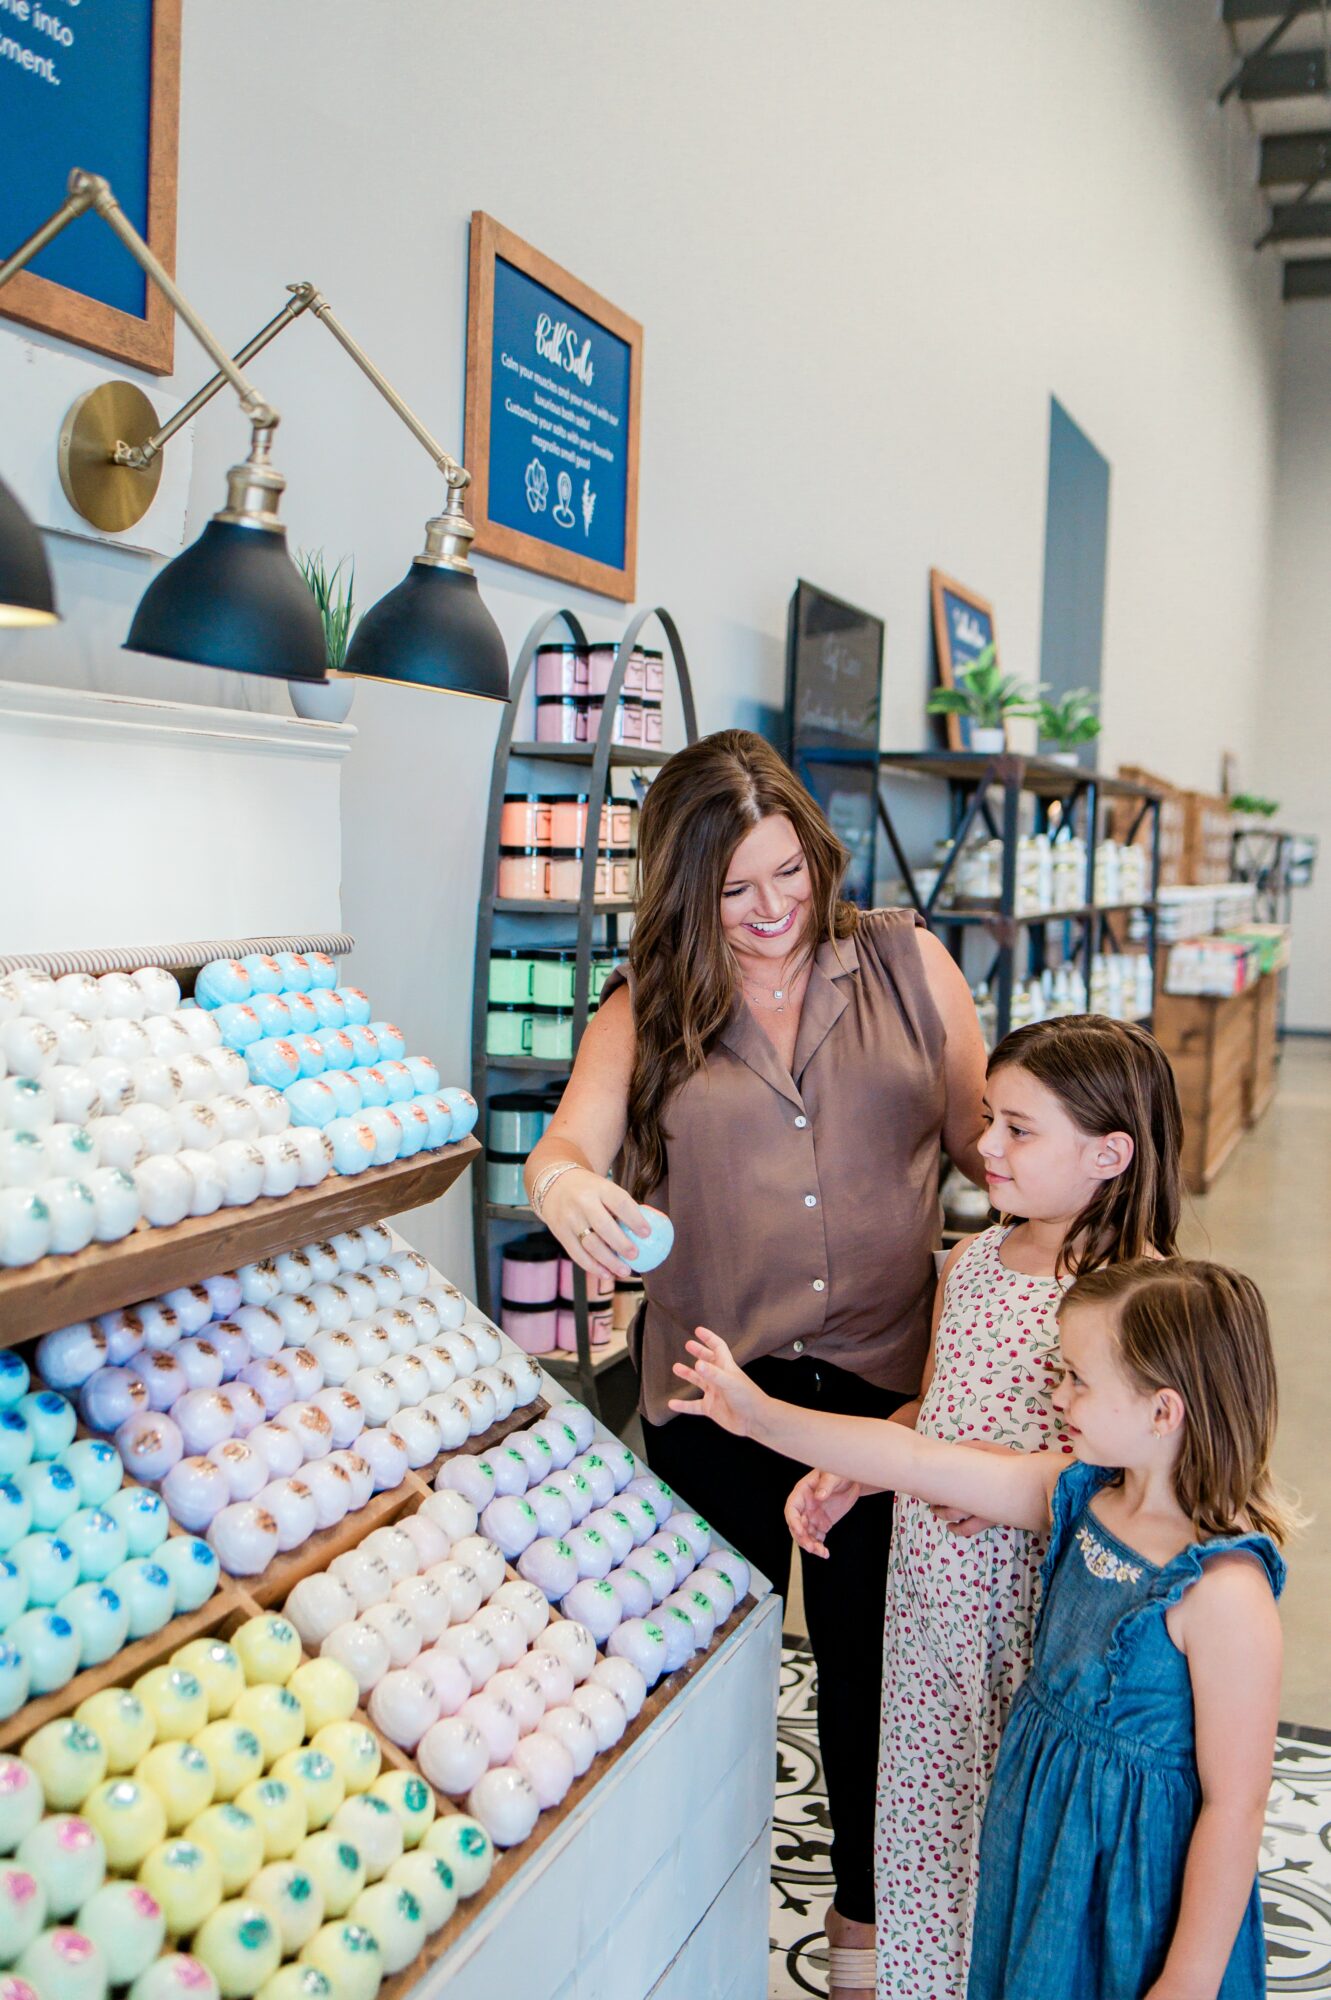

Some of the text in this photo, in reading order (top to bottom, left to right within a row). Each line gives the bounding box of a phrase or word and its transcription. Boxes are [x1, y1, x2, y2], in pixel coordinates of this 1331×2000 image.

[32, 3, 74, 46] into
[0, 34, 61, 86] ment.
[501, 352, 519, 372] Calm
[519, 364, 533, 379] your
[534, 313, 595, 386] Bath Salts
[504, 397, 538, 425] Customize
[538, 417, 553, 431] your
[561, 405, 575, 423] bath
